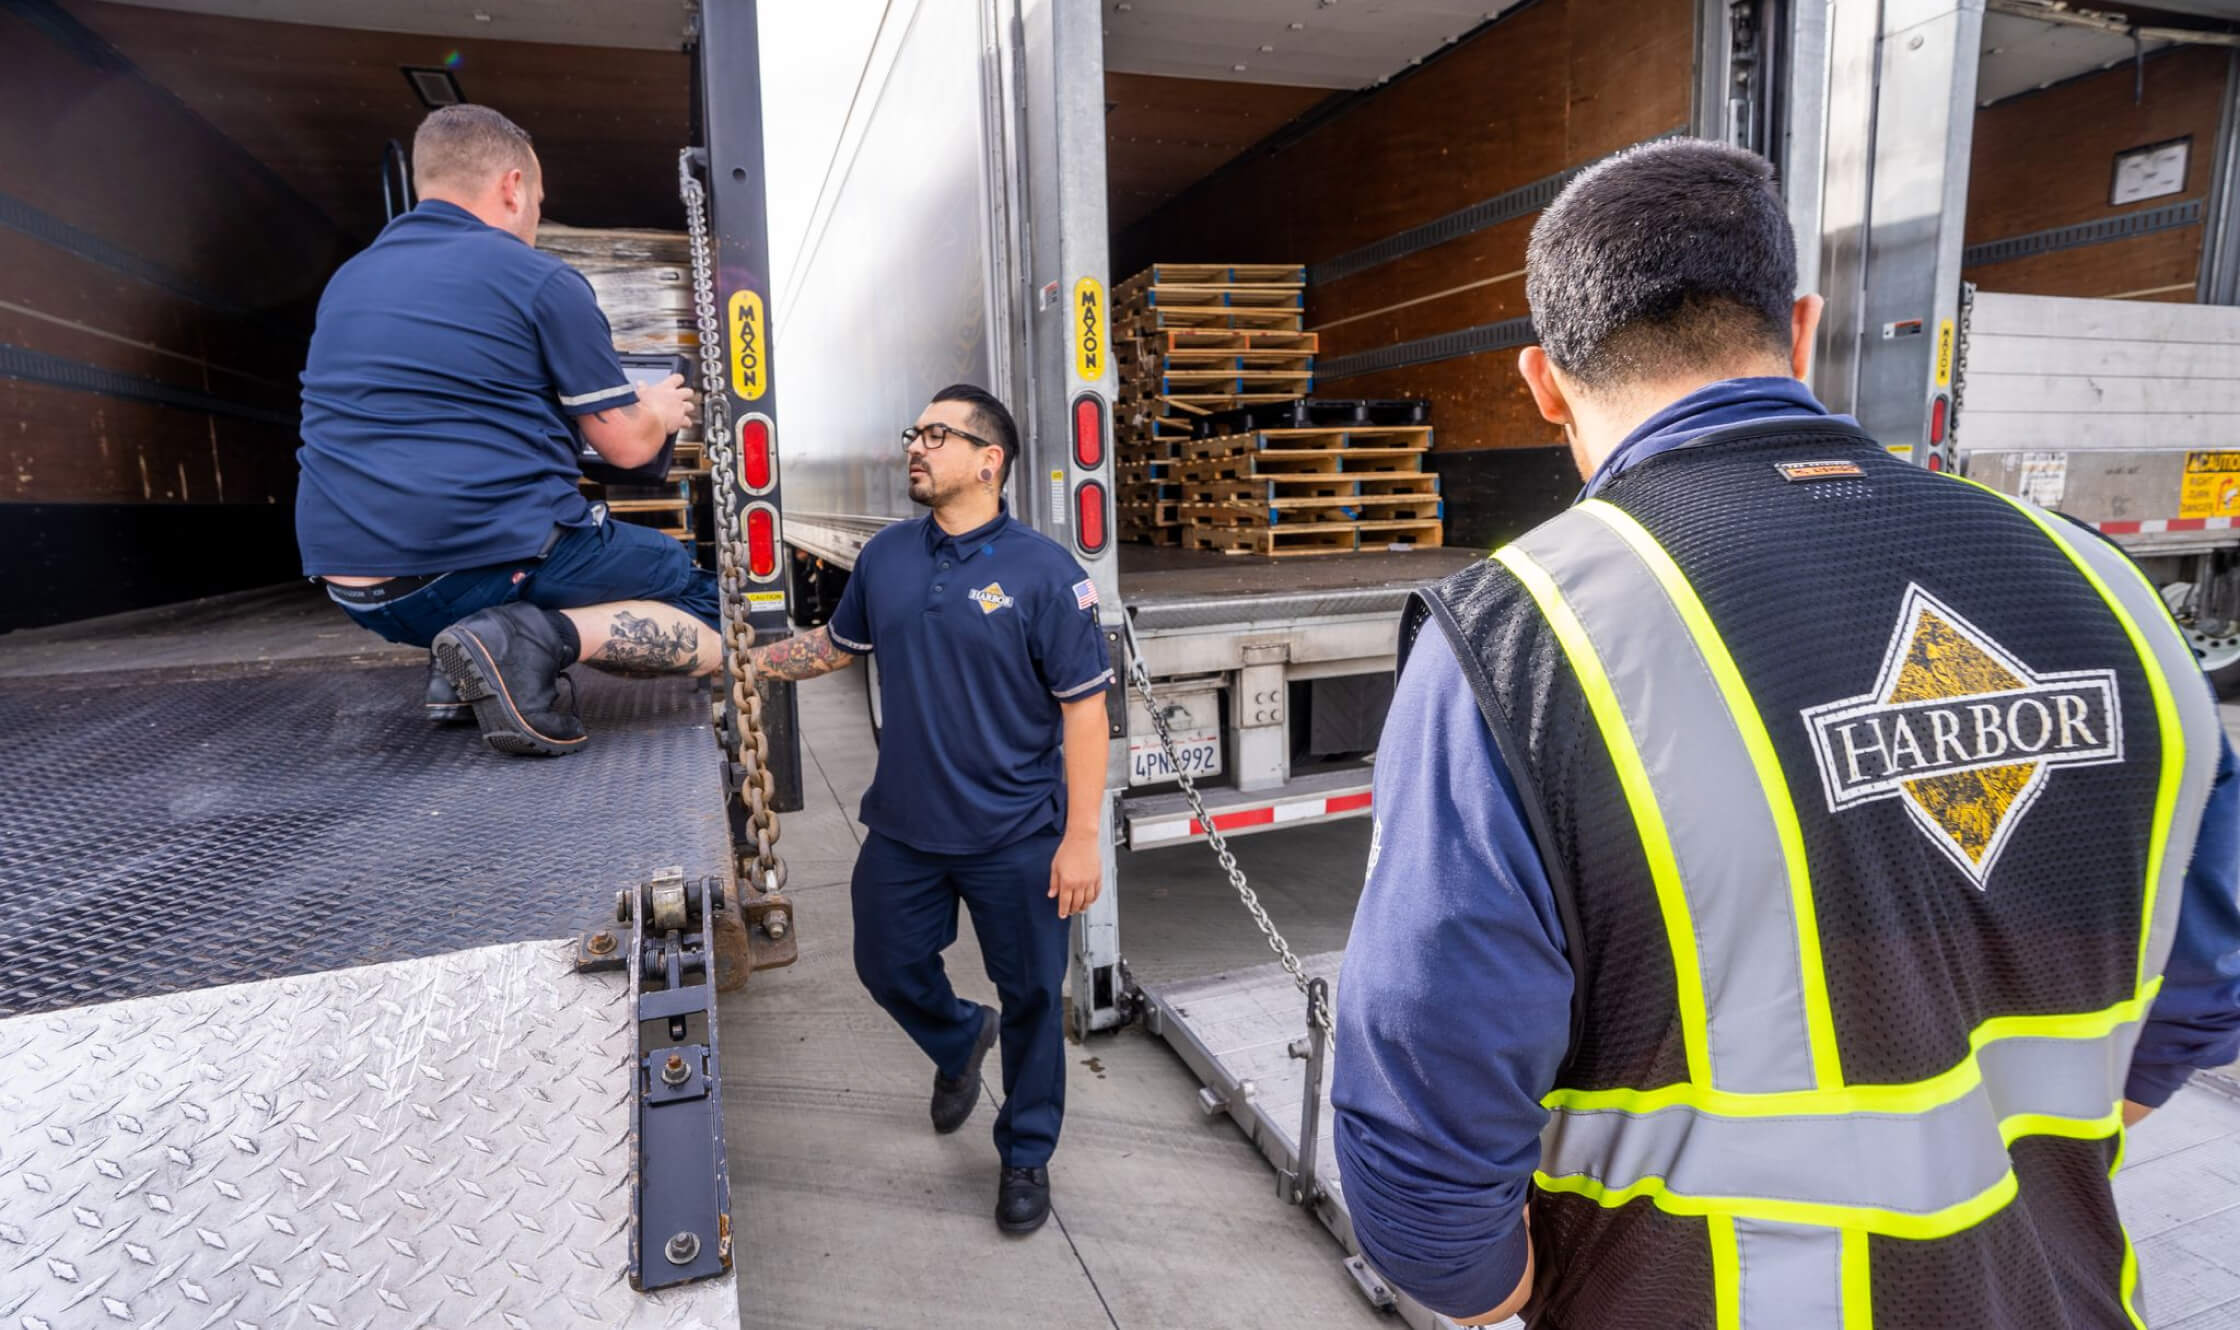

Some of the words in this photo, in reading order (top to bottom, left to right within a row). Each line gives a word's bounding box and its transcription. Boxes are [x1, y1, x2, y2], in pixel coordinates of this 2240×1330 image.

[738, 304, 757, 387] MAXON
[1081, 291, 1097, 369] MAXON
[750, 594, 783, 602] CAUTION
[1835, 694, 2099, 785] HARBOR
